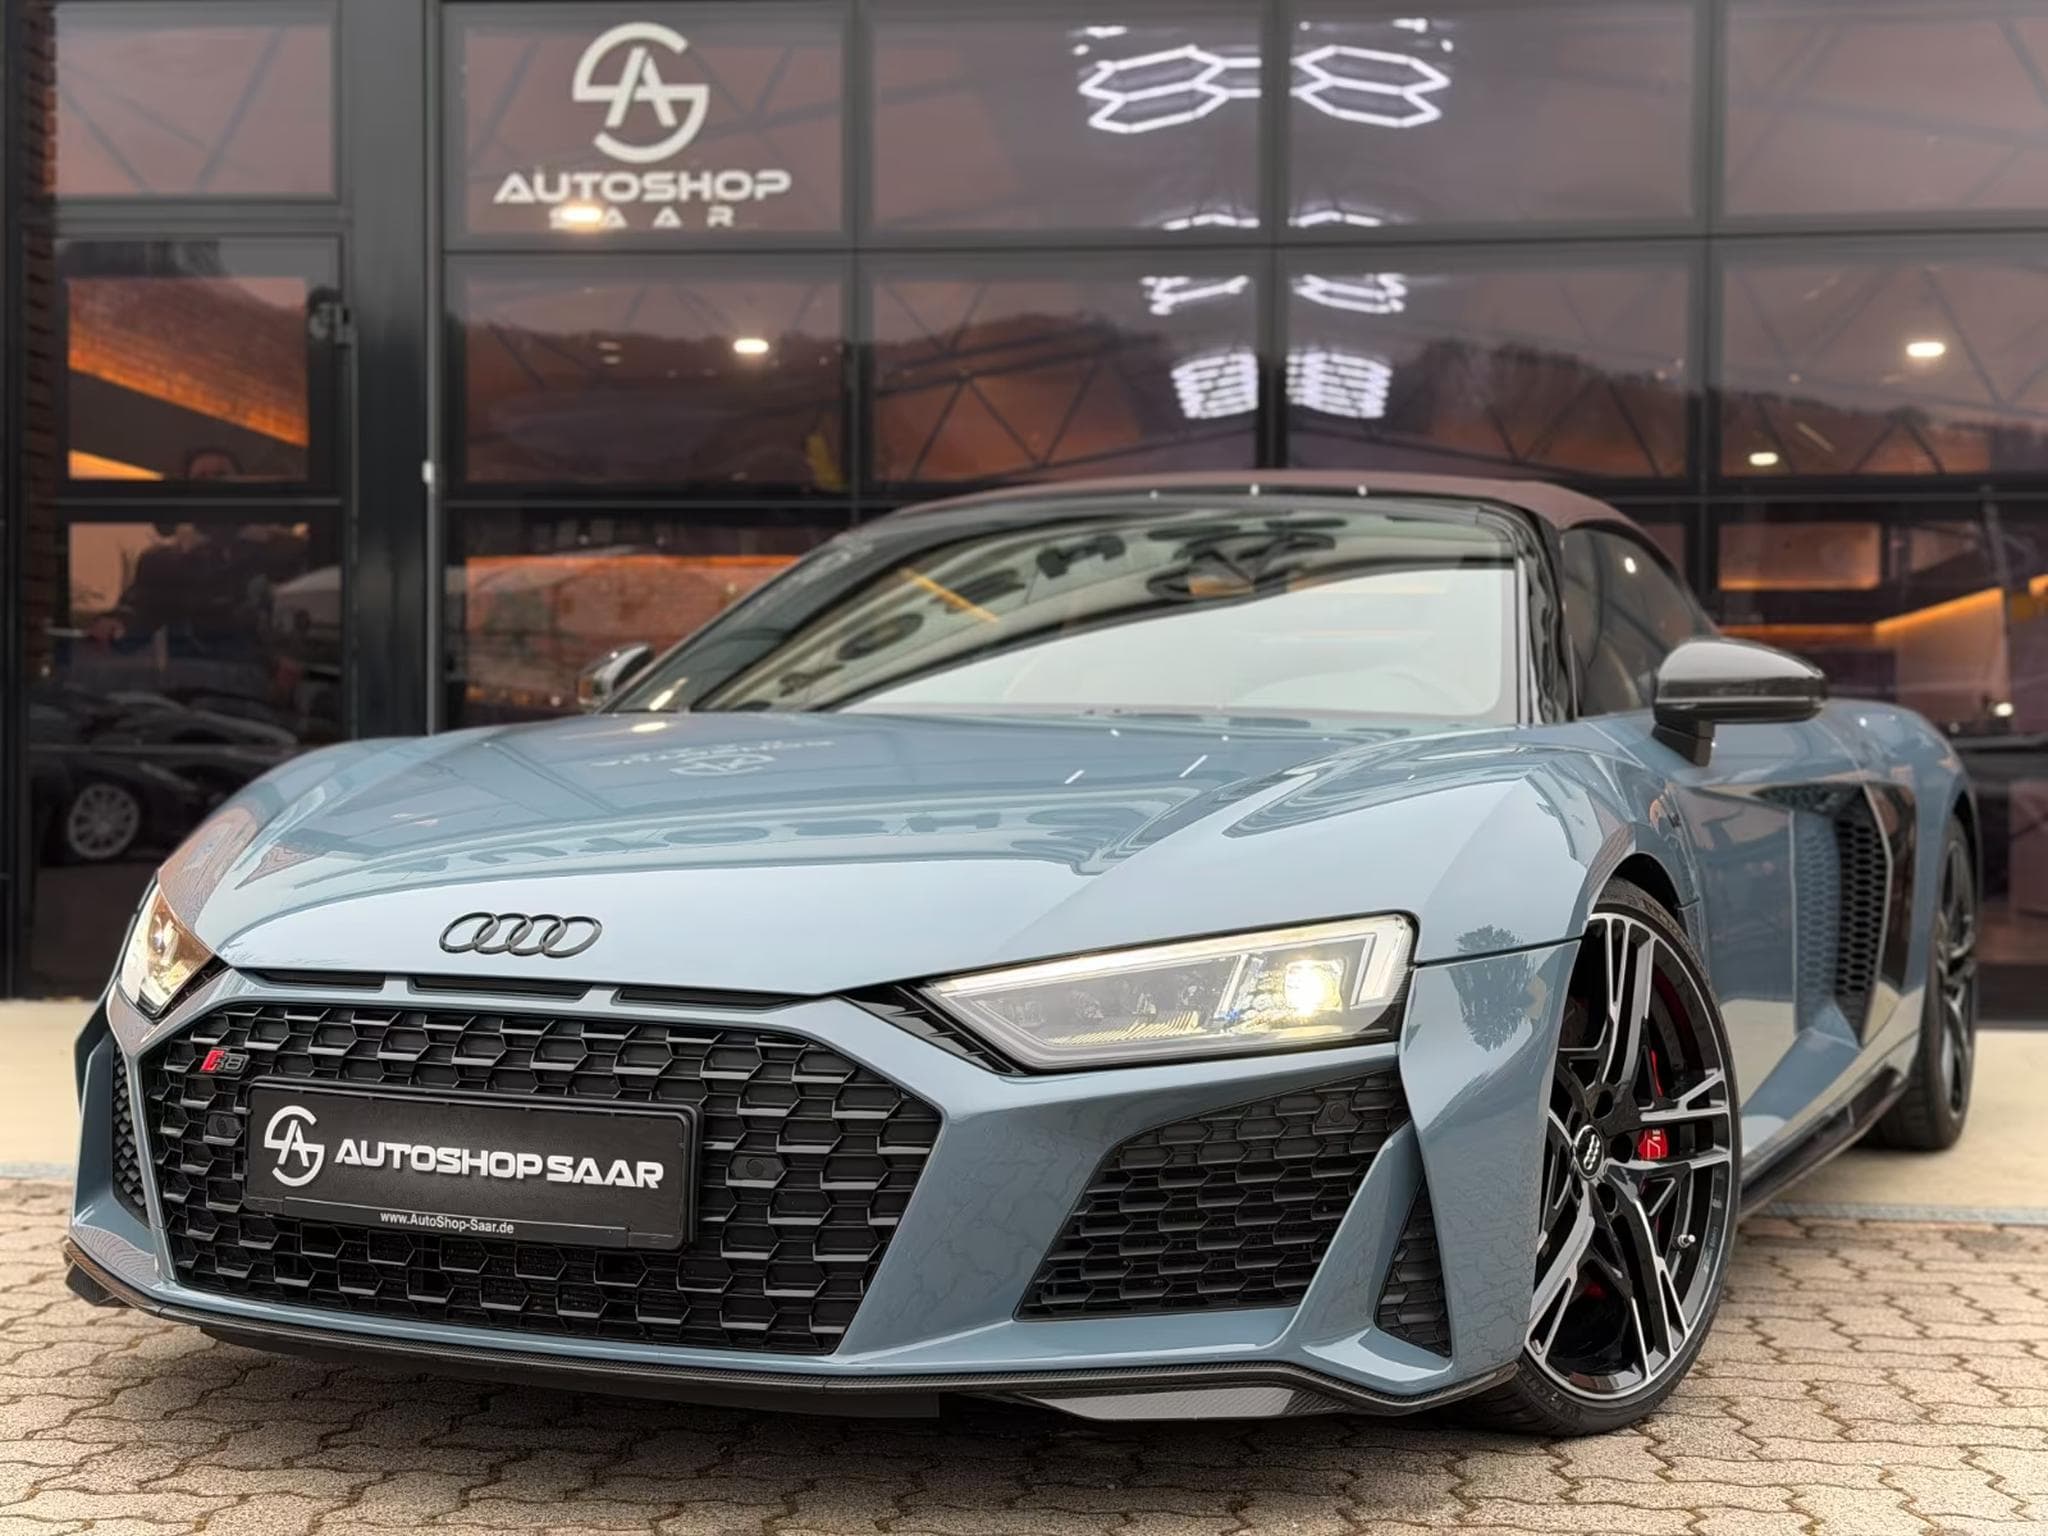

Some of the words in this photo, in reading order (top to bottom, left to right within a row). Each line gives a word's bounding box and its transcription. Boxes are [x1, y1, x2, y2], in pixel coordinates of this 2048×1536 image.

[493, 170, 792, 203] AUTOSHOP
[334, 1138, 543, 1180] AUTOSHOP
[546, 1155, 665, 1189] SAAR
[379, 1211, 515, 1234] www.AutoShop-Saar.de
